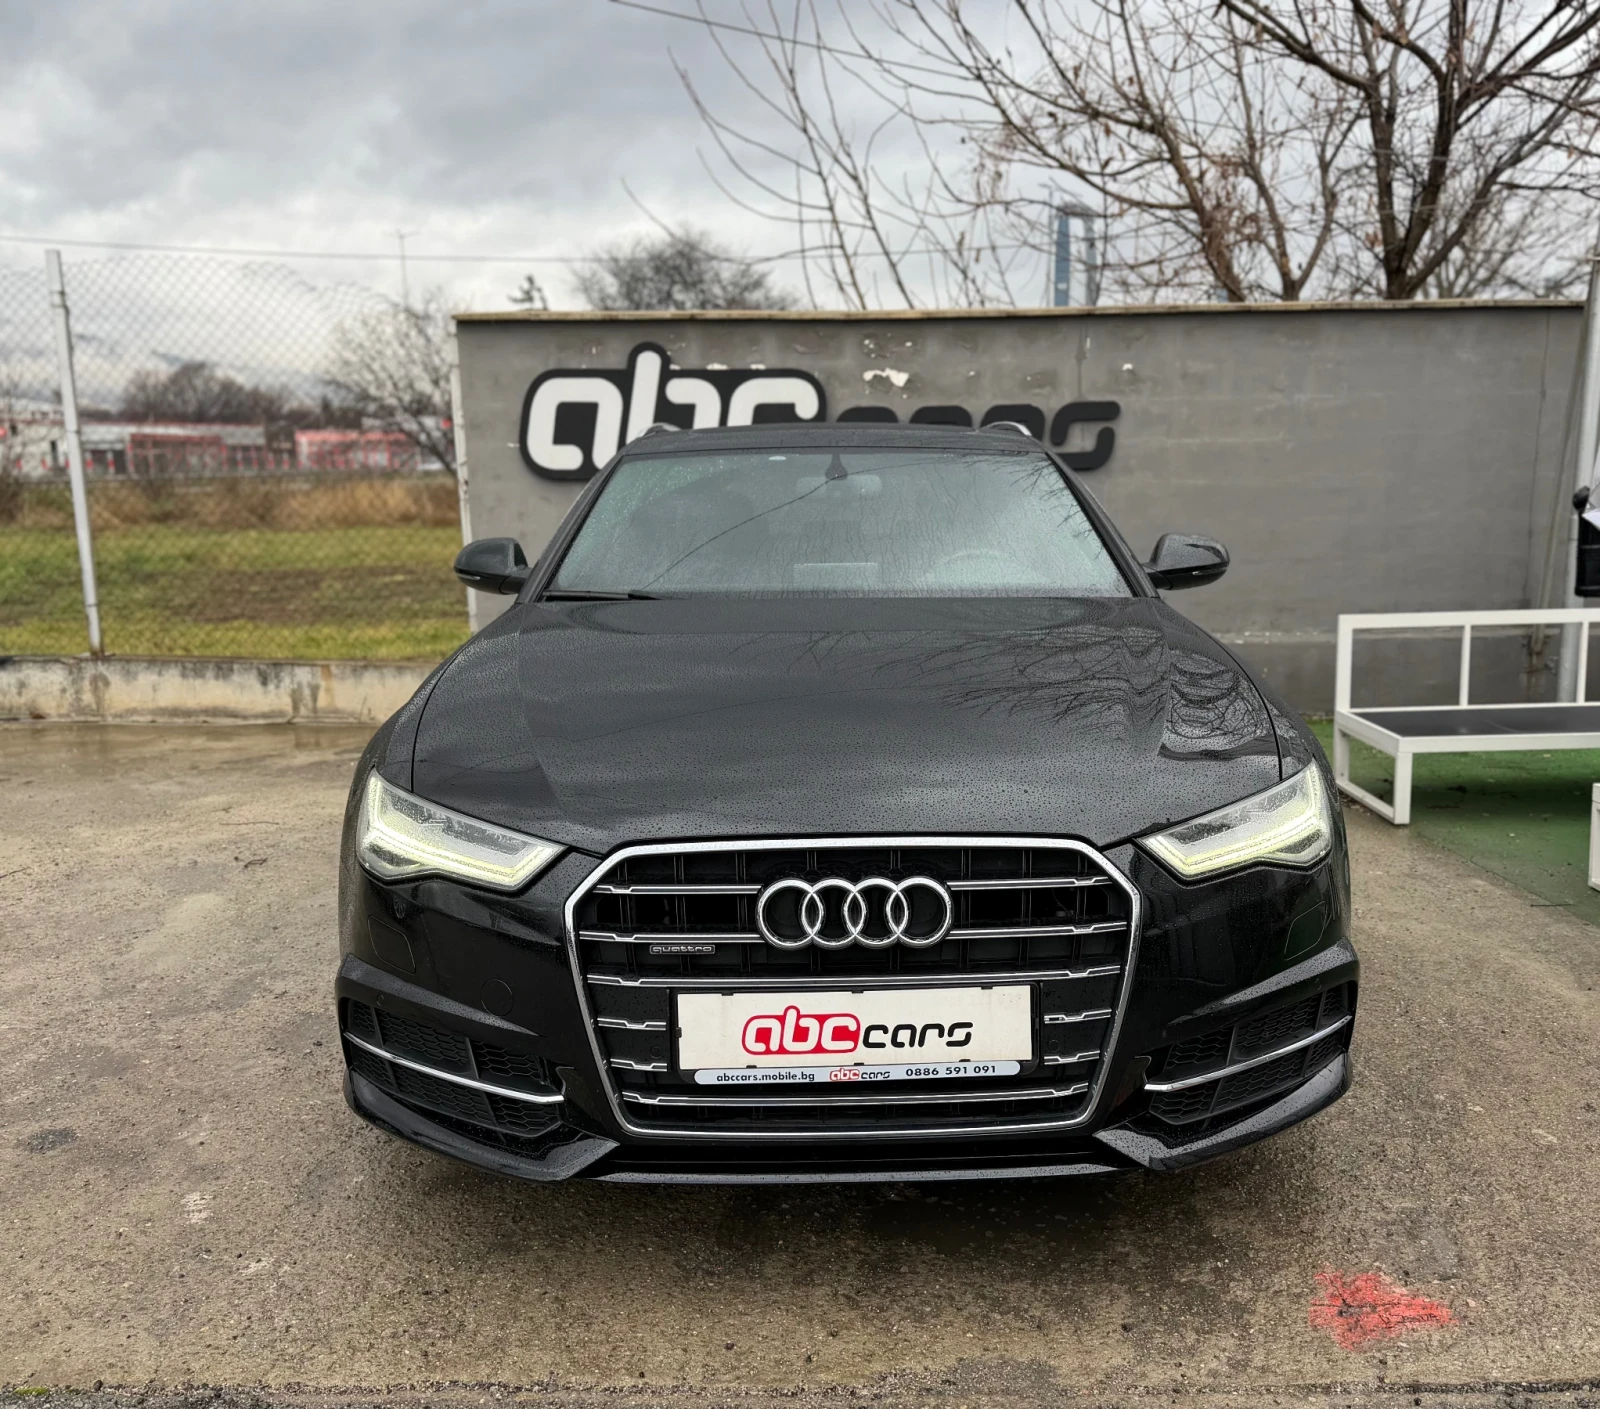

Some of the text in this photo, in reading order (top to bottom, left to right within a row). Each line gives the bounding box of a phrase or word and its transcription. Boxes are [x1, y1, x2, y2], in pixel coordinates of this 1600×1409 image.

[652, 946, 712, 954] quattro
[743, 1006, 974, 1054] abc cars
[716, 1065, 996, 1082] abccars.mobile.bg abc cars 0886 591 091
